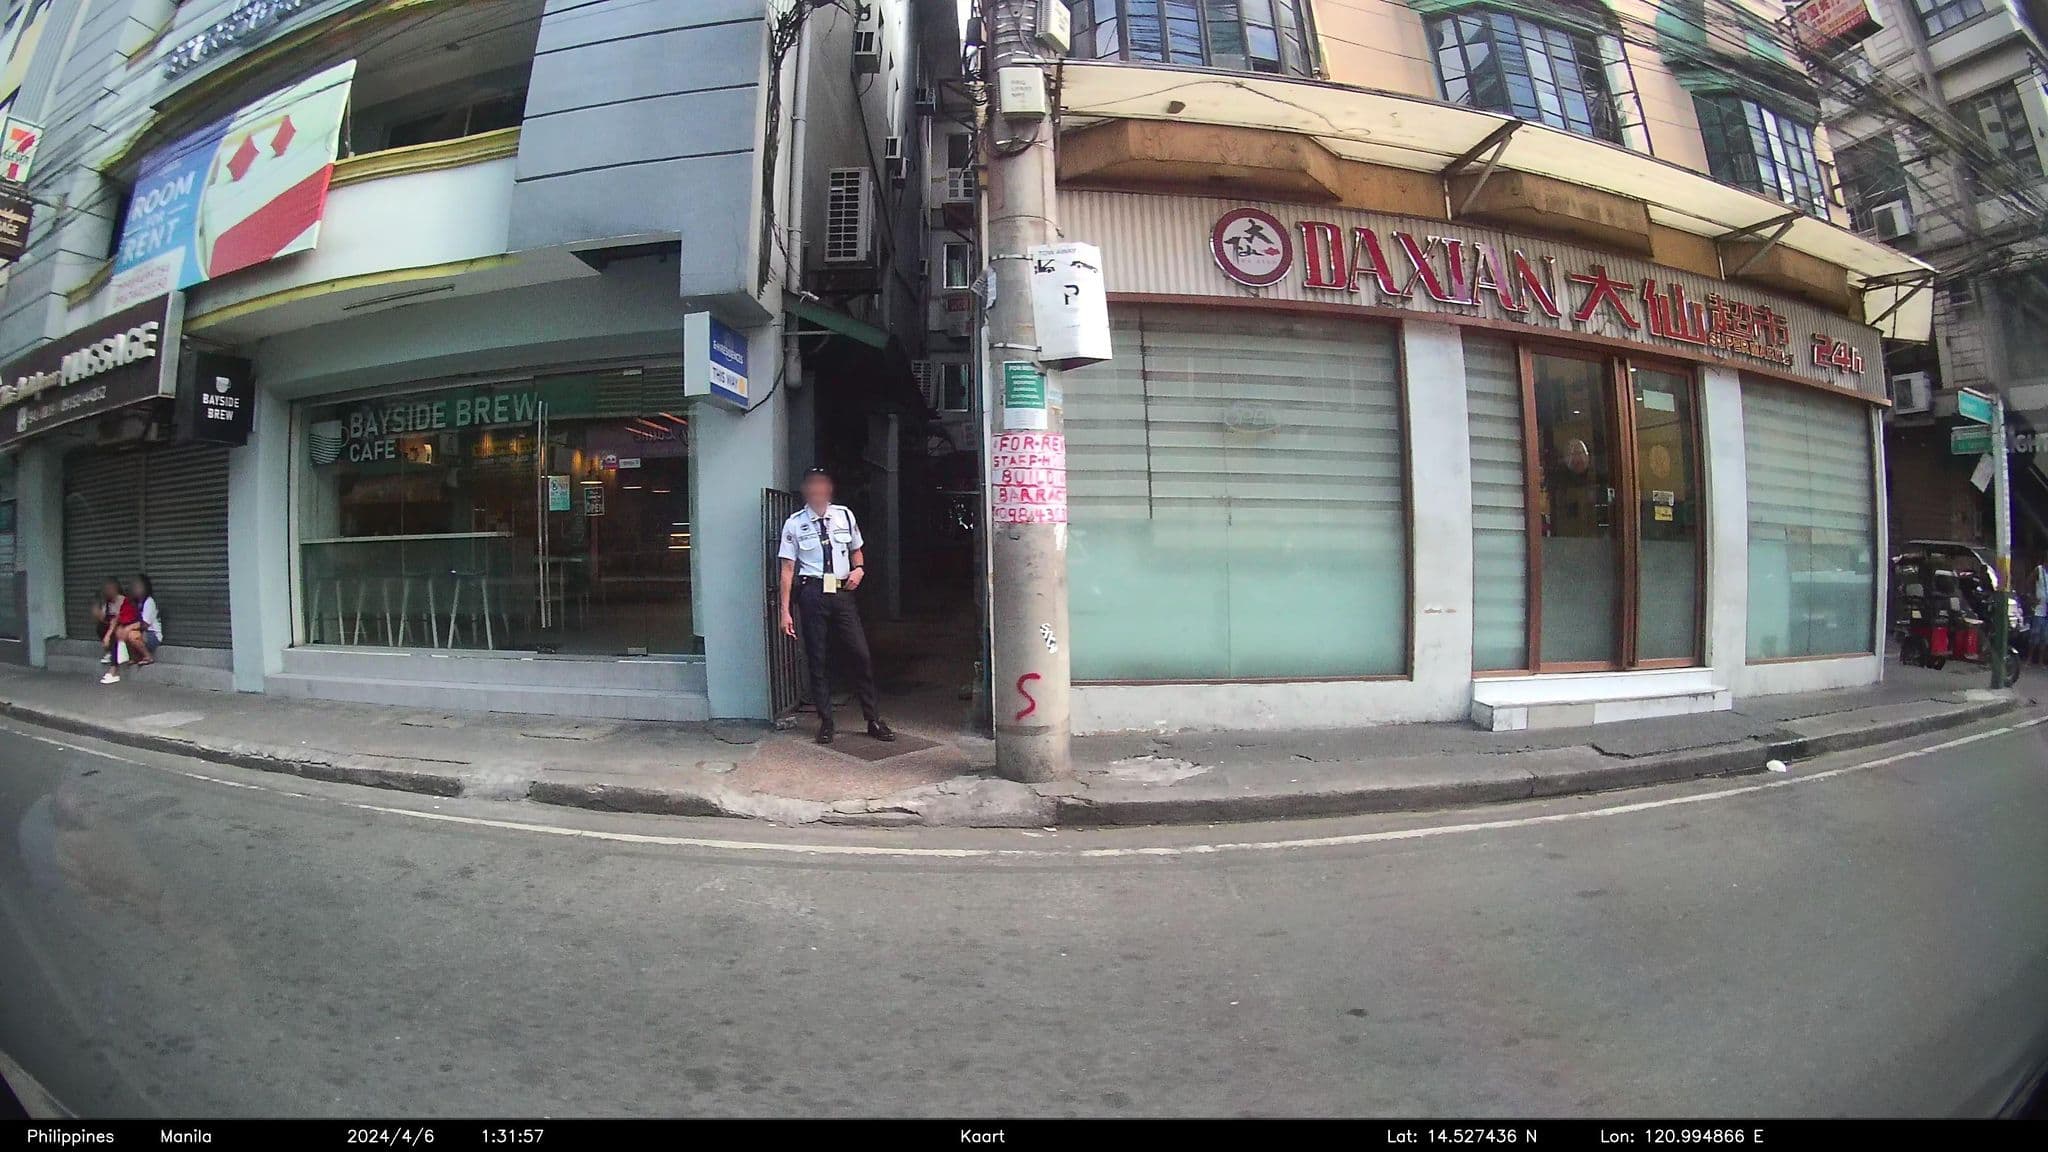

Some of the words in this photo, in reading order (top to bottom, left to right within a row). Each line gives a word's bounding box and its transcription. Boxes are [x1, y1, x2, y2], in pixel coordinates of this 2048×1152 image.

[131, 170, 195, 221] ROOM
[121, 217, 180, 263] RENT
[1295, 219, 1562, 319] DAXIAN
[1566, 263, 1708, 346] 大仙
[61, 320, 159, 387] MASSAGE
[1812, 332, 1865, 375] 24h
[202, 392, 240, 409] BAYSIDE
[207, 408, 234, 421] BREW
[350, 402, 446, 439] BAYSIDE
[456, 392, 539, 427] BREW
[350, 438, 396, 462] CAFE
